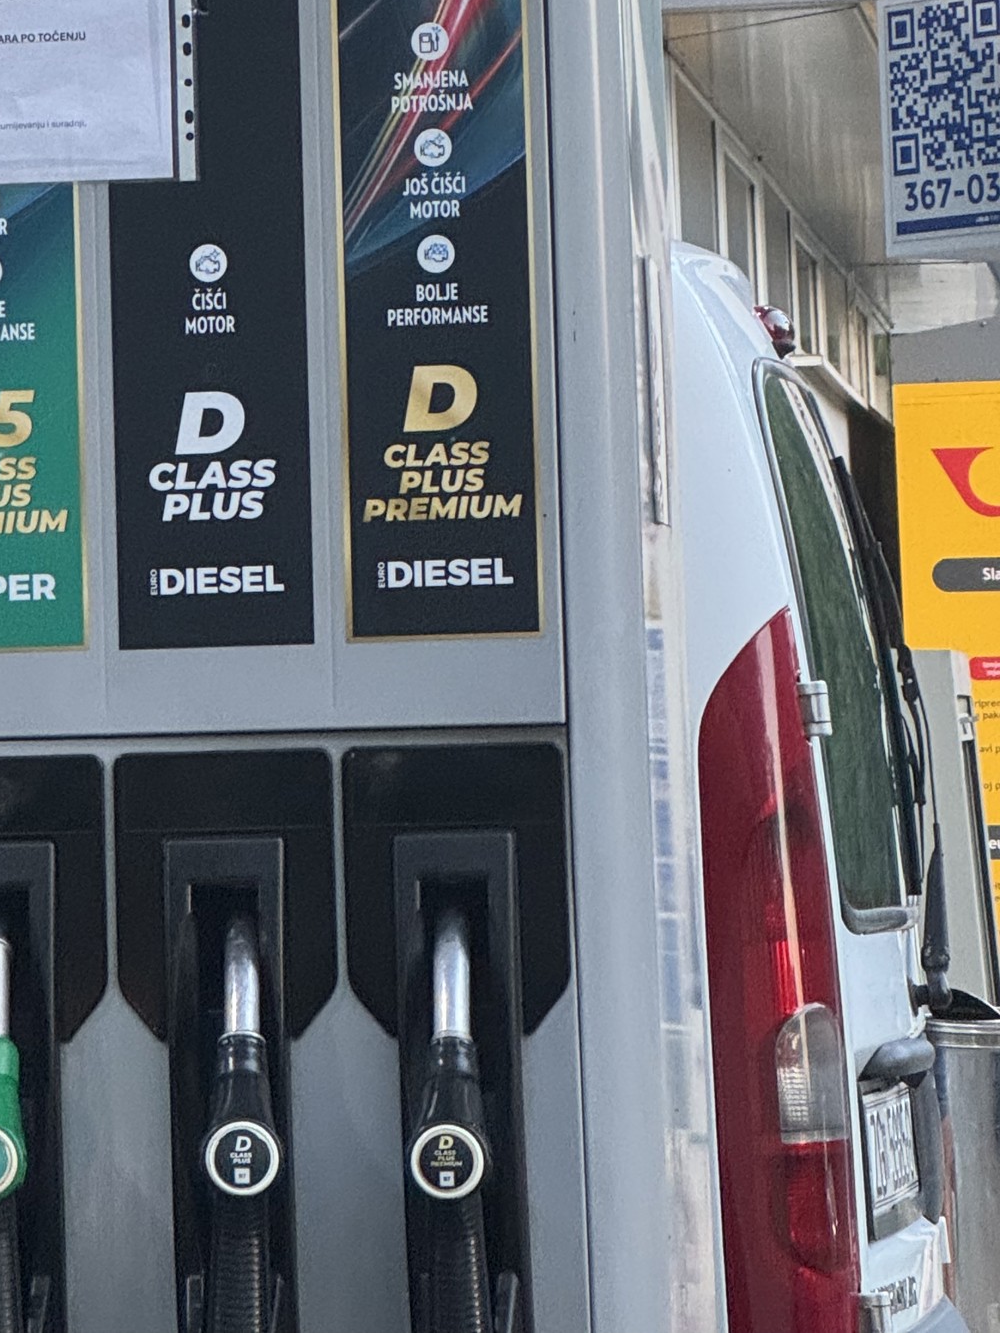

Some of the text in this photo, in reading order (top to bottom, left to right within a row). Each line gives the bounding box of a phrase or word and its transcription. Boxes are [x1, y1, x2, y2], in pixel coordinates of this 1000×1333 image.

[20, 33, 36, 43] PO
[37, 30, 87, 43] TOČENJU
[393, 68, 469, 90] SMANJENA
[391, 89, 474, 114] POTROŠNJA
[402, 173, 467, 197] JOŠ ČIŠĆI
[905, 173, 1000, 211] 367-03
[410, 201, 461, 219] MOTOR
[191, 287, 227, 311] ČIŠĆI
[415, 282, 459, 303] BOLJE
[185, 316, 236, 335] MOTOR
[387, 305, 489, 327] PERFORMANSE
[403, 364, 478, 433] D
[174, 391, 246, 455] D
[384, 440, 490, 468] CLASS
[149, 458, 277, 492] CLASS
[399, 468, 485, 494] PLUS
[162, 491, 264, 522] PLUS
[363, 493, 523, 523] PREMIUM
[150, 564, 285, 596] EURO DIESEL
[378, 557, 514, 589] EURO DIESEL
[235, 1135, 252, 1152] D
[438, 1135, 454, 1150] D
